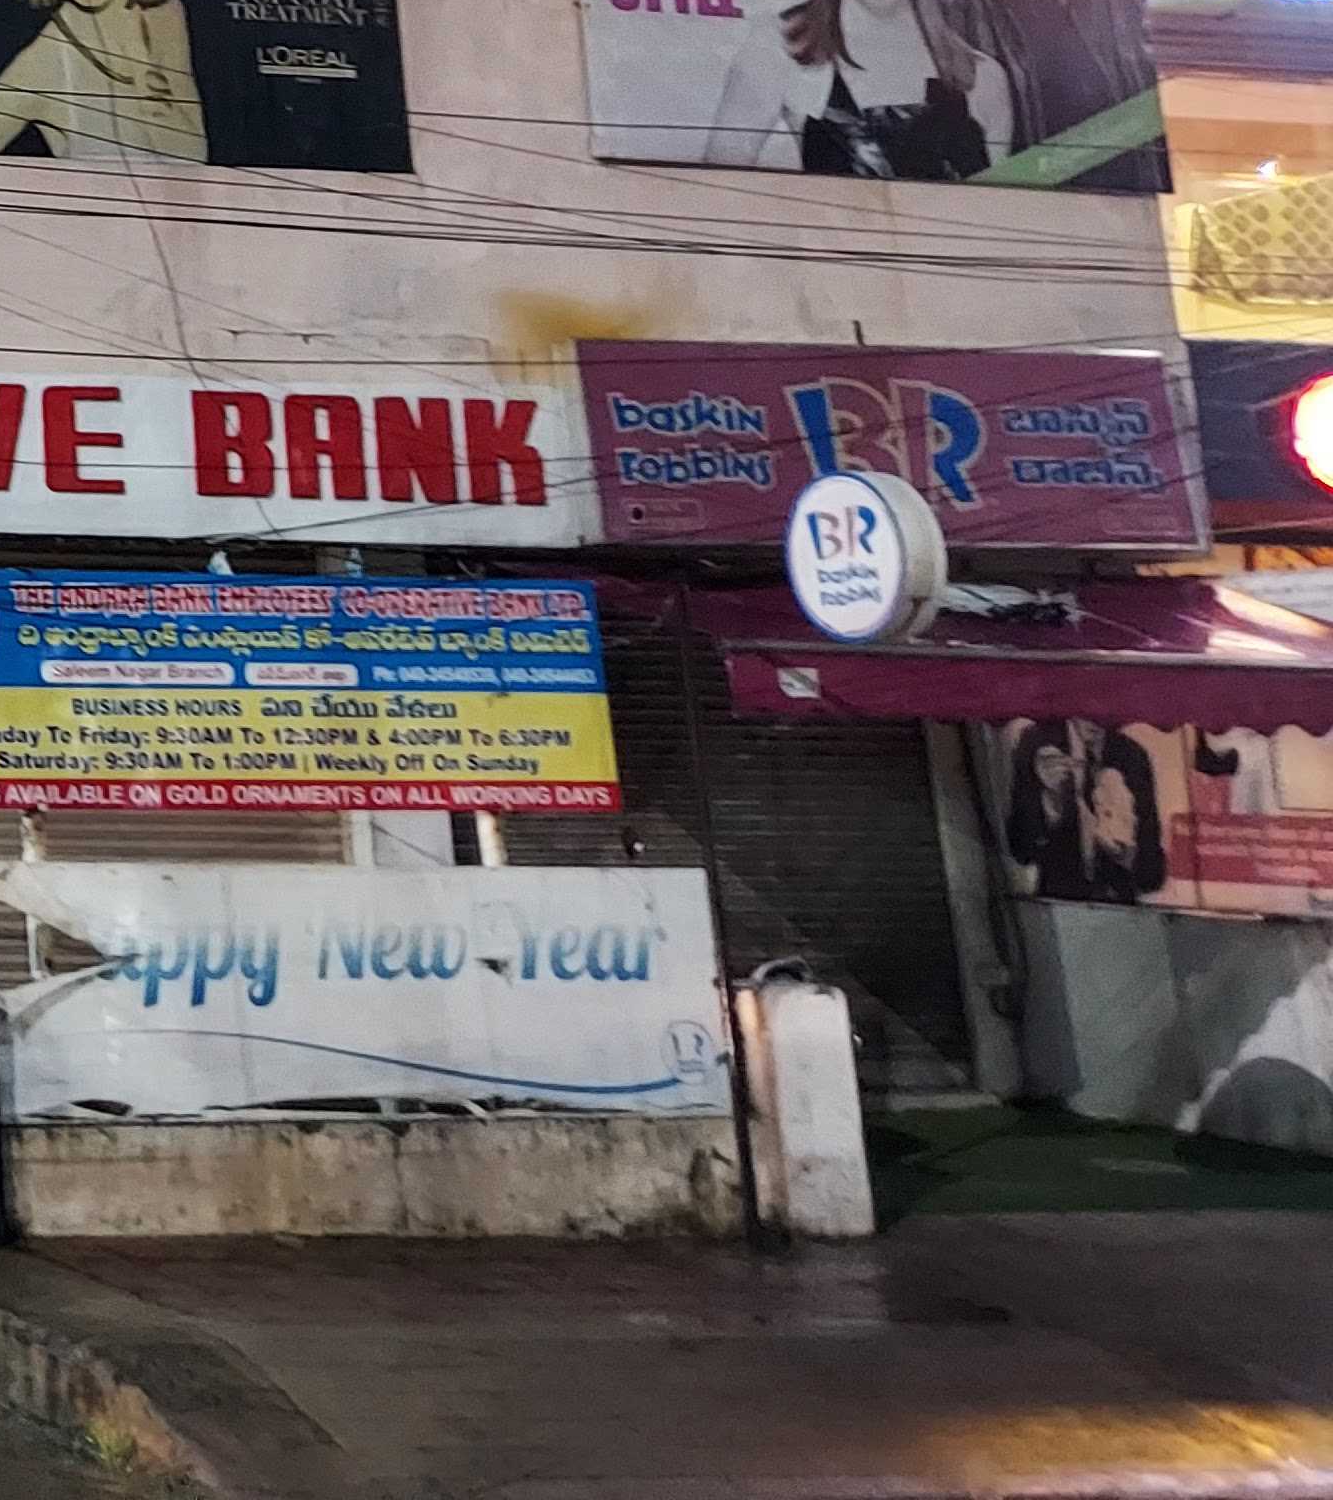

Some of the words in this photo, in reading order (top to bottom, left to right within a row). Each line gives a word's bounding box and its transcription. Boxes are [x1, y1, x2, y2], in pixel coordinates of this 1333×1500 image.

[225, 1, 369, 26] TREATMENT
[607, 393, 768, 438] baskin
[195, 389, 549, 506] BANK
[618, 447, 775, 487] robbins
[806, 504, 877, 561] BR
[167, 665, 224, 680] Branch
[71, 698, 169, 717] BUSINESS
[176, 700, 242, 717] HOURS
[47, 727, 71, 744] To
[79, 726, 150, 748] Friday:
[156, 728, 234, 745] 9:30AM
[241, 727, 265, 744] To
[274, 728, 359, 745] 12:30PM
[366, 730, 381, 746] &
[389, 729, 462, 746] 4:00PM
[469, 729, 494, 746] To
[500, 730, 571, 746] 6:30PM
[107, 753, 182, 770] 9:30AM
[189, 753, 215, 770] To
[223, 753, 295, 771] 1:00PM
[315, 753, 388, 776] Weekly
[394, 754, 425, 771] Off
[433, 755, 460, 772] On
[467, 754, 539, 776] Sunday
[4, 784, 125, 805] AVAILABLE
[129, 785, 162, 805] ON
[166, 786, 228, 805] GOLD
[232, 786, 366, 806] ORNAMENTS
[370, 787, 405, 806] ON
[406, 787, 447, 806] ALL
[451, 787, 551, 806] WORKING
[555, 787, 612, 806] DAYS
[305, 920, 467, 982] New
